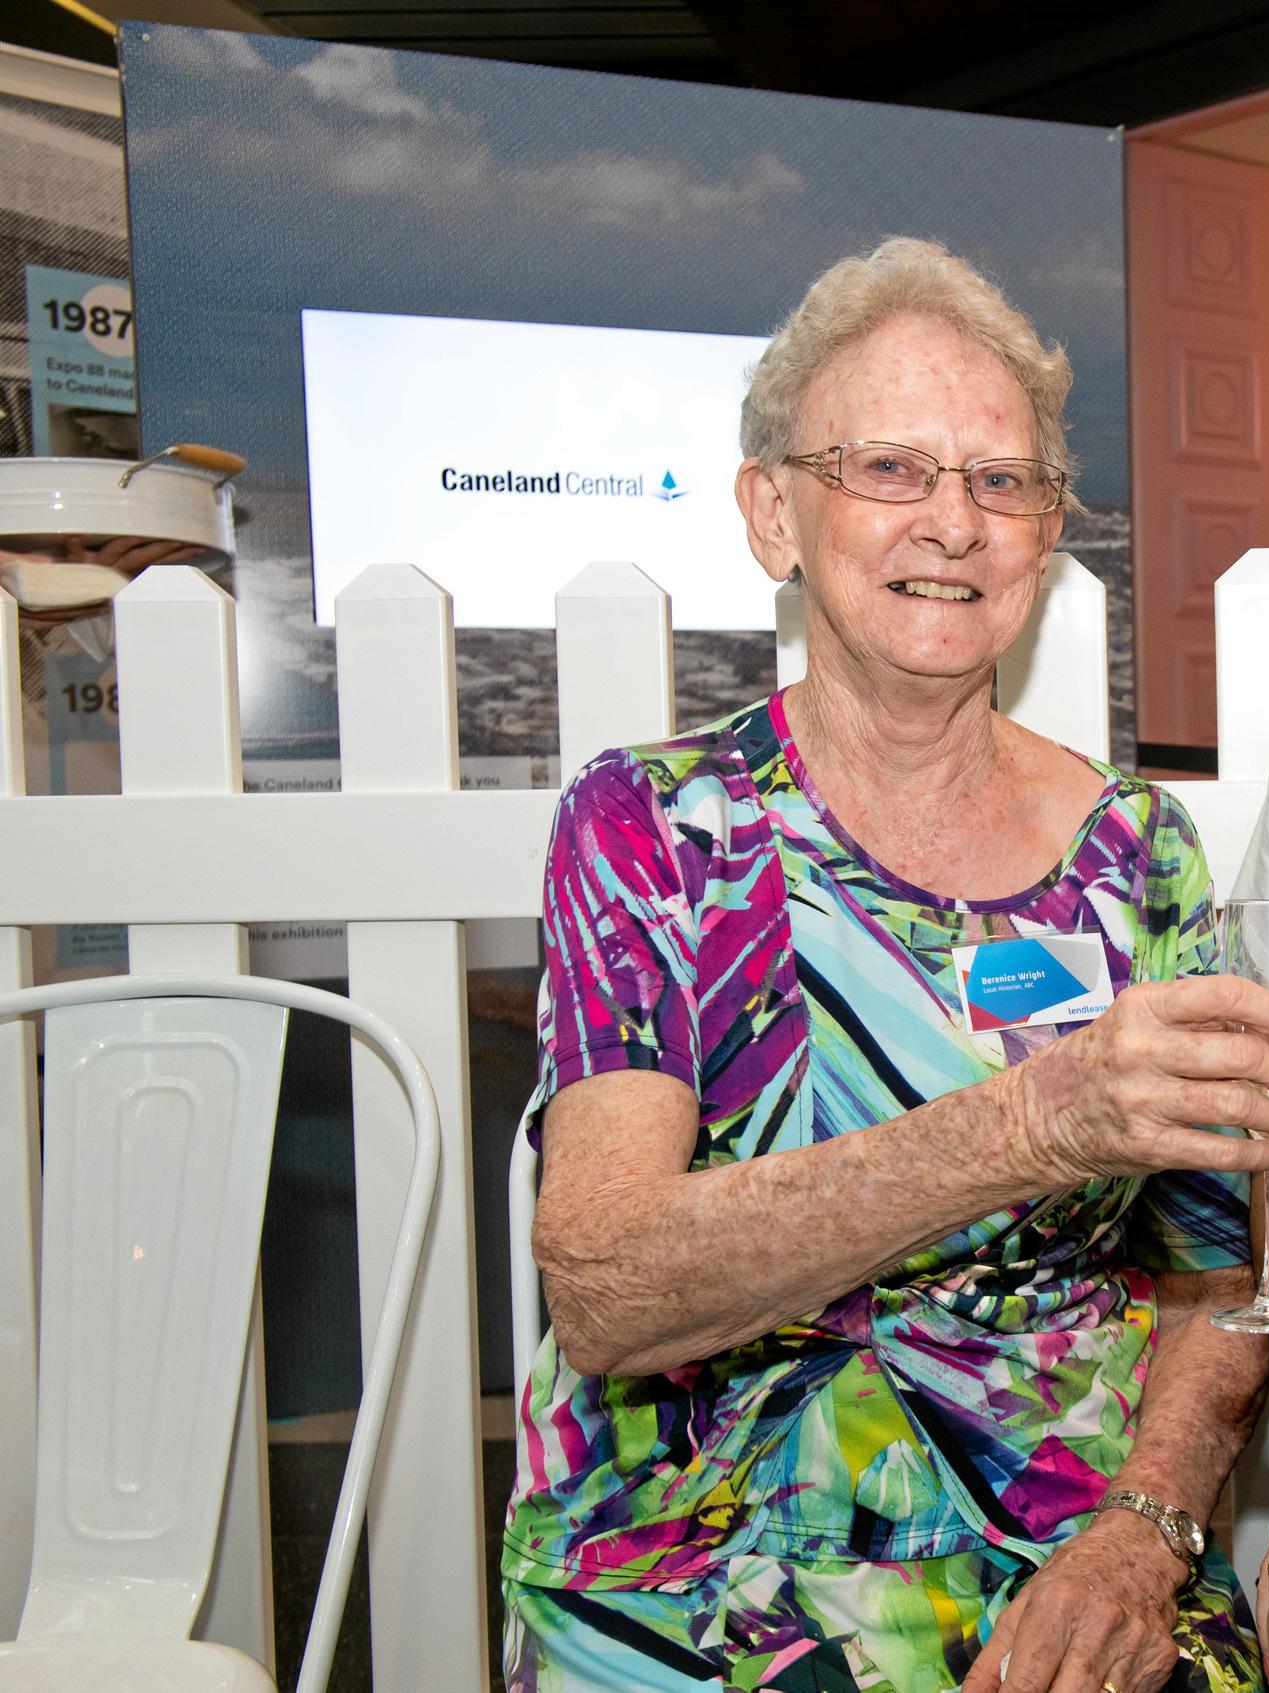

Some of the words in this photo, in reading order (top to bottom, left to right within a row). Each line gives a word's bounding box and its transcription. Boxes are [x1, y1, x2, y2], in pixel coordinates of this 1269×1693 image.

[43, 299, 132, 339] 1987
[46, 357, 83, 374] Expo
[46, 378, 63, 391] to
[65, 379, 134, 399] Caneland
[441, 467, 560, 494] Caneland
[565, 470, 643, 497] Central
[264, 776, 334, 792] Caneland
[271, 925, 343, 941] exhibition
[981, 974, 1016, 986] Berenice
[1018, 970, 1046, 982] Wright
[1067, 1003, 1109, 1015] lendlease
